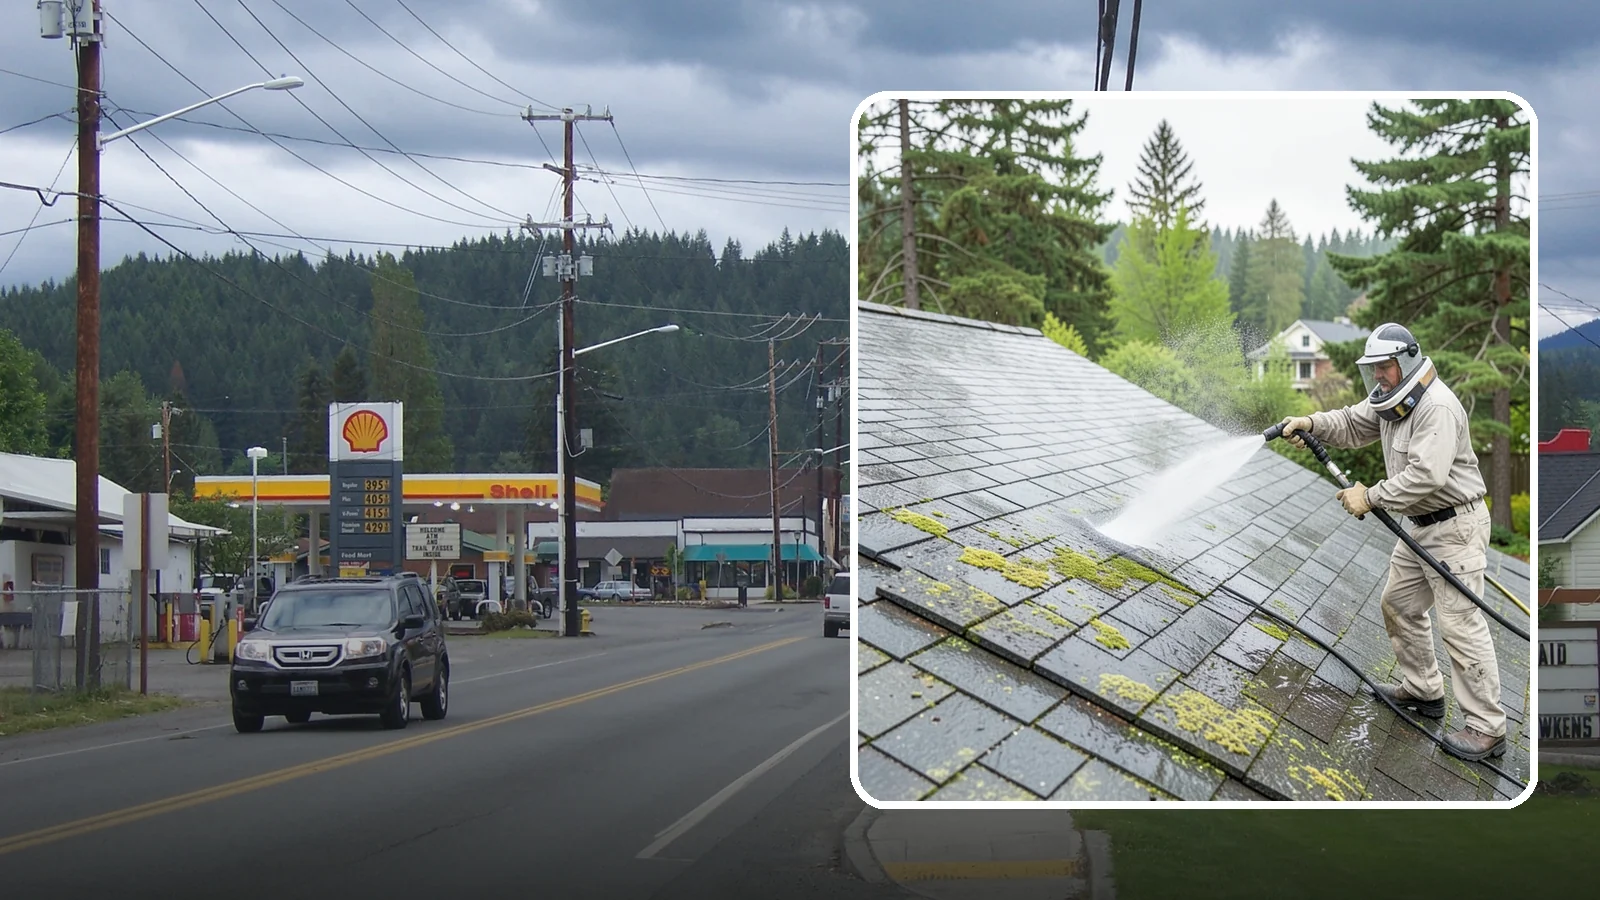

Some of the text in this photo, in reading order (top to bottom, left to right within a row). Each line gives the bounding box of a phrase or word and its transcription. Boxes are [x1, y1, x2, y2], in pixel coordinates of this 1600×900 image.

[366, 480, 383, 490] 395
[490, 484, 547, 499] Shell
[366, 494, 383, 504] 405
[366, 508, 383, 518] 415
[366, 522, 383, 532] 429
